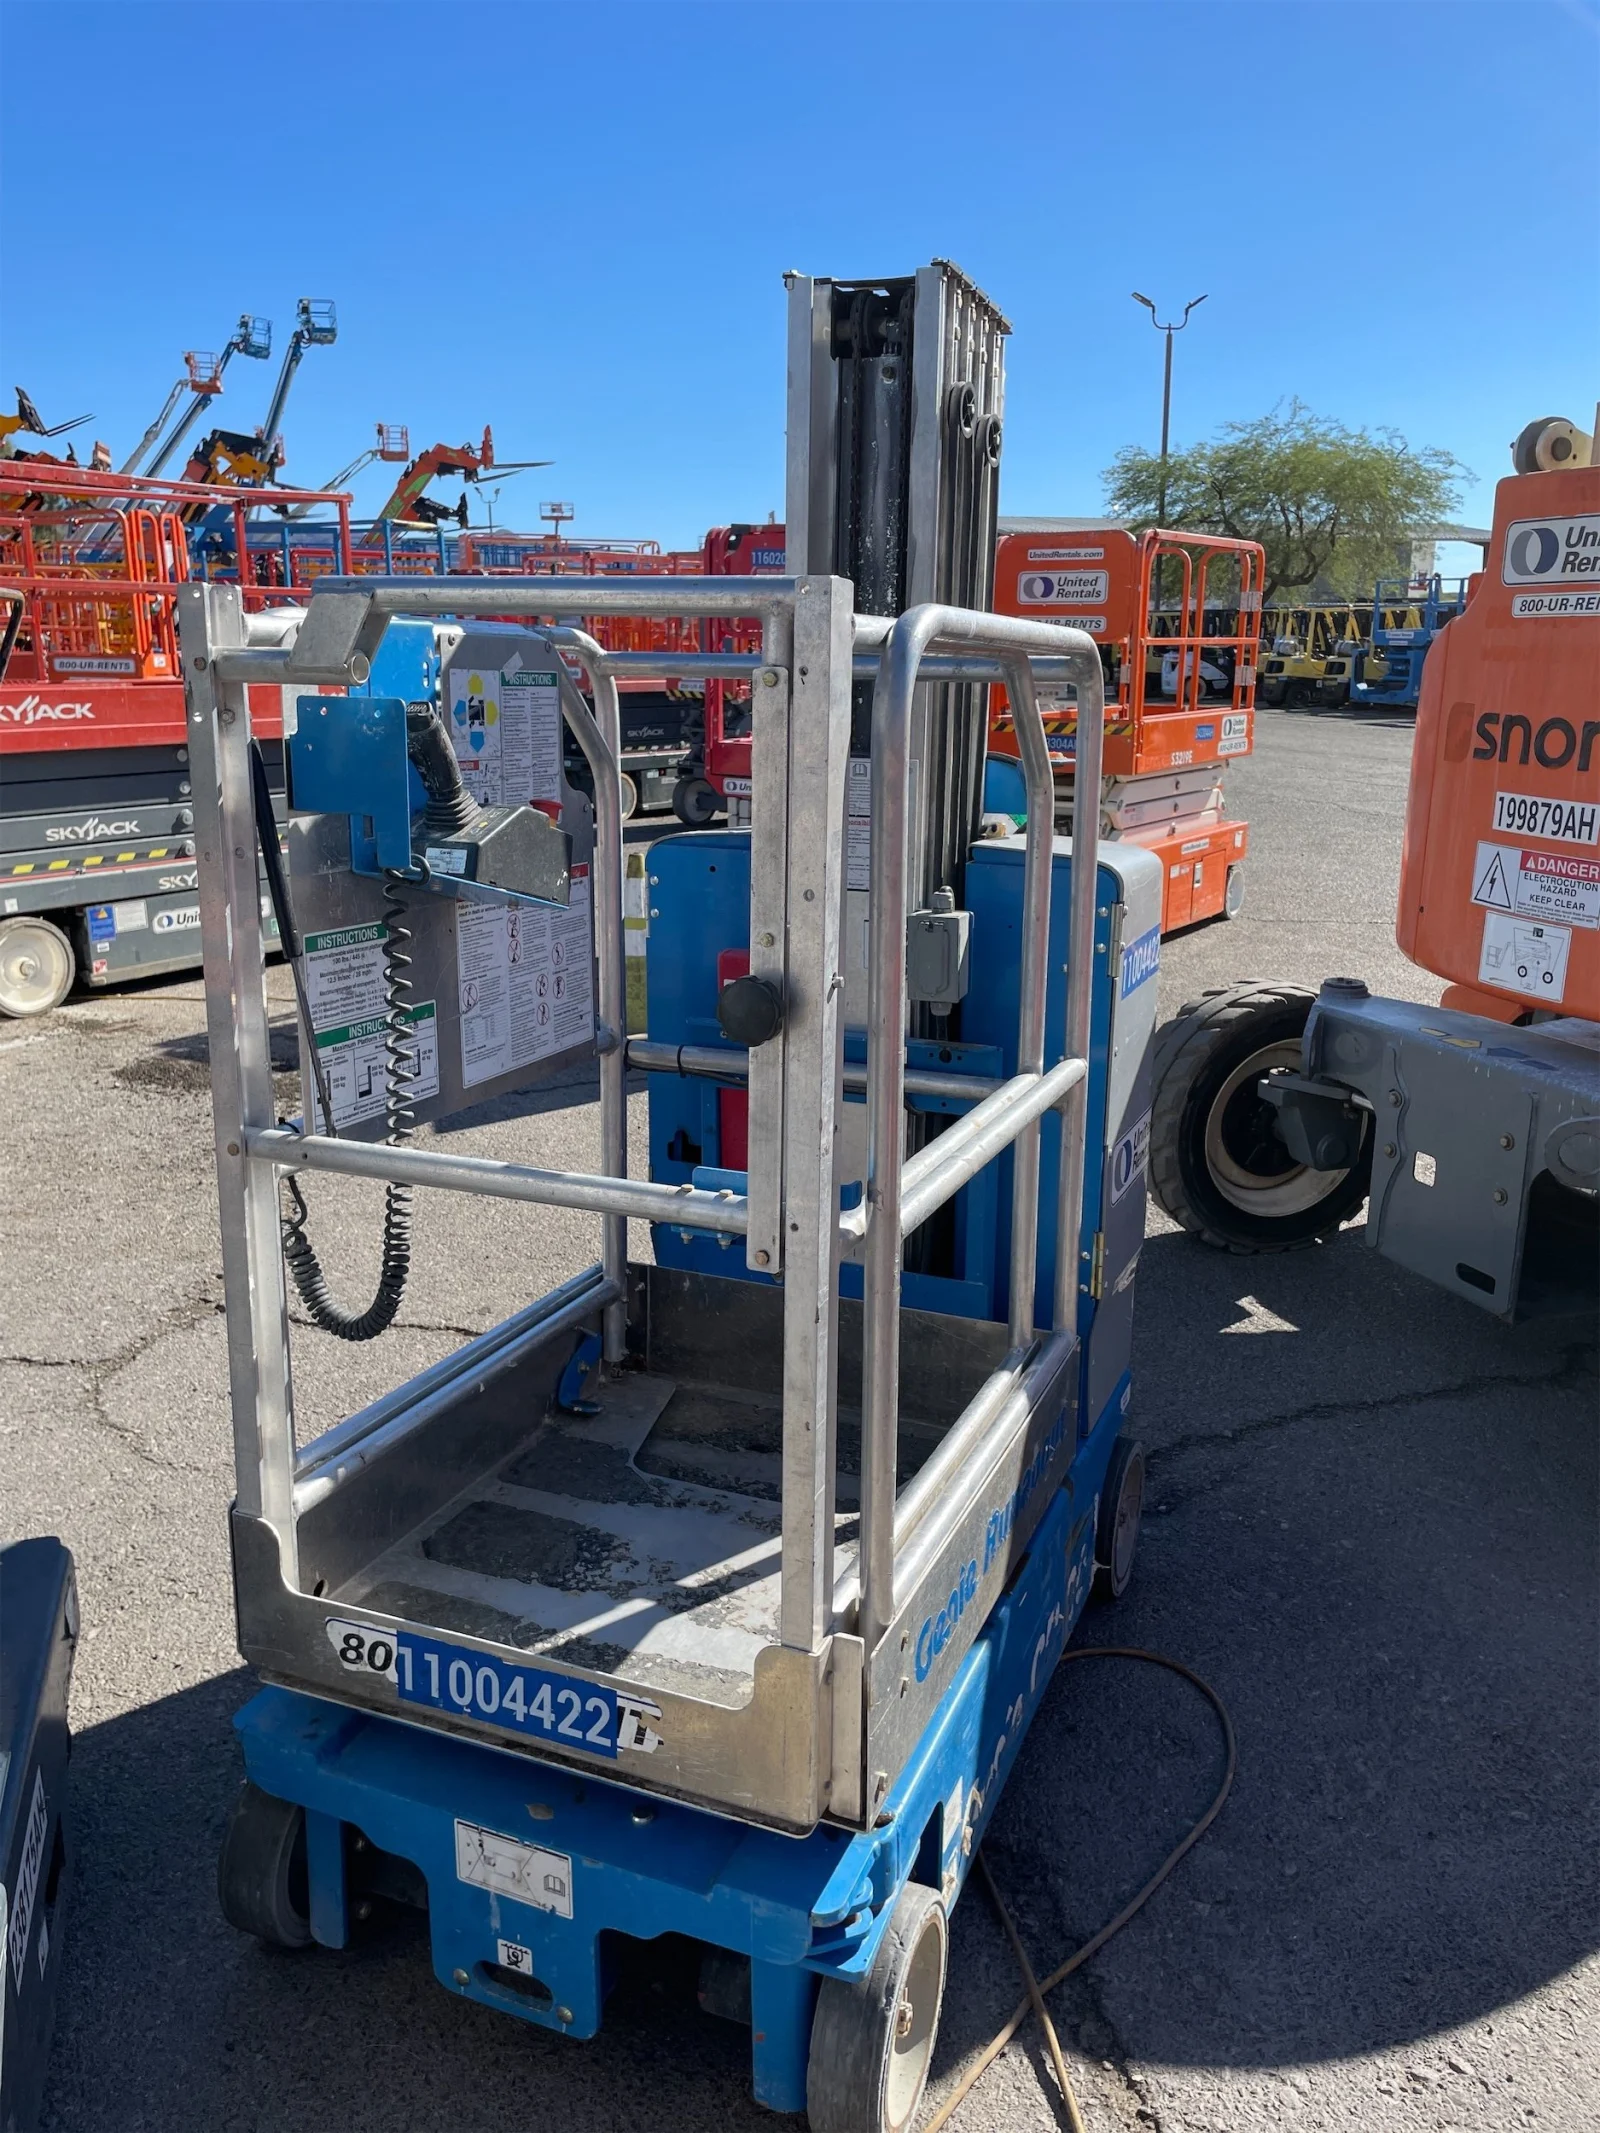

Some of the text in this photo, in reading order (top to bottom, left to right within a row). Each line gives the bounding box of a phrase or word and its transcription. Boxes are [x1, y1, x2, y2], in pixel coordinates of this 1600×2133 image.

[1029, 551, 1103, 559] UnitedRentals.com
[1057, 576, 1099, 587] United
[1056, 588, 1102, 599] Rentals
[58, 660, 131, 671] 800-UR-RENTS
[627, 726, 664, 738] SKYJACK
[1473, 713, 1600, 771] snor
[46, 817, 141, 841] SKYJACK
[1498, 797, 1597, 841] 199879AH
[1537, 856, 1600, 880] DANGER
[158, 869, 198, 890] SKY
[1524, 872, 1598, 893] ELECTROCUTION
[1540, 884, 1577, 898] HAZARD
[1529, 894, 1586, 911] KEEP CLEAR
[317, 926, 378, 949] INSTRUCTIONS
[1122, 932, 1161, 993] 11004422
[349, 1016, 405, 1038] INSTRUCNS
[914, 1557, 979, 1685] Genie
[339, 1633, 398, 1674] 80
[398, 1645, 612, 1748] 11004422
[12, 1786, 47, 1981] 238175AH
